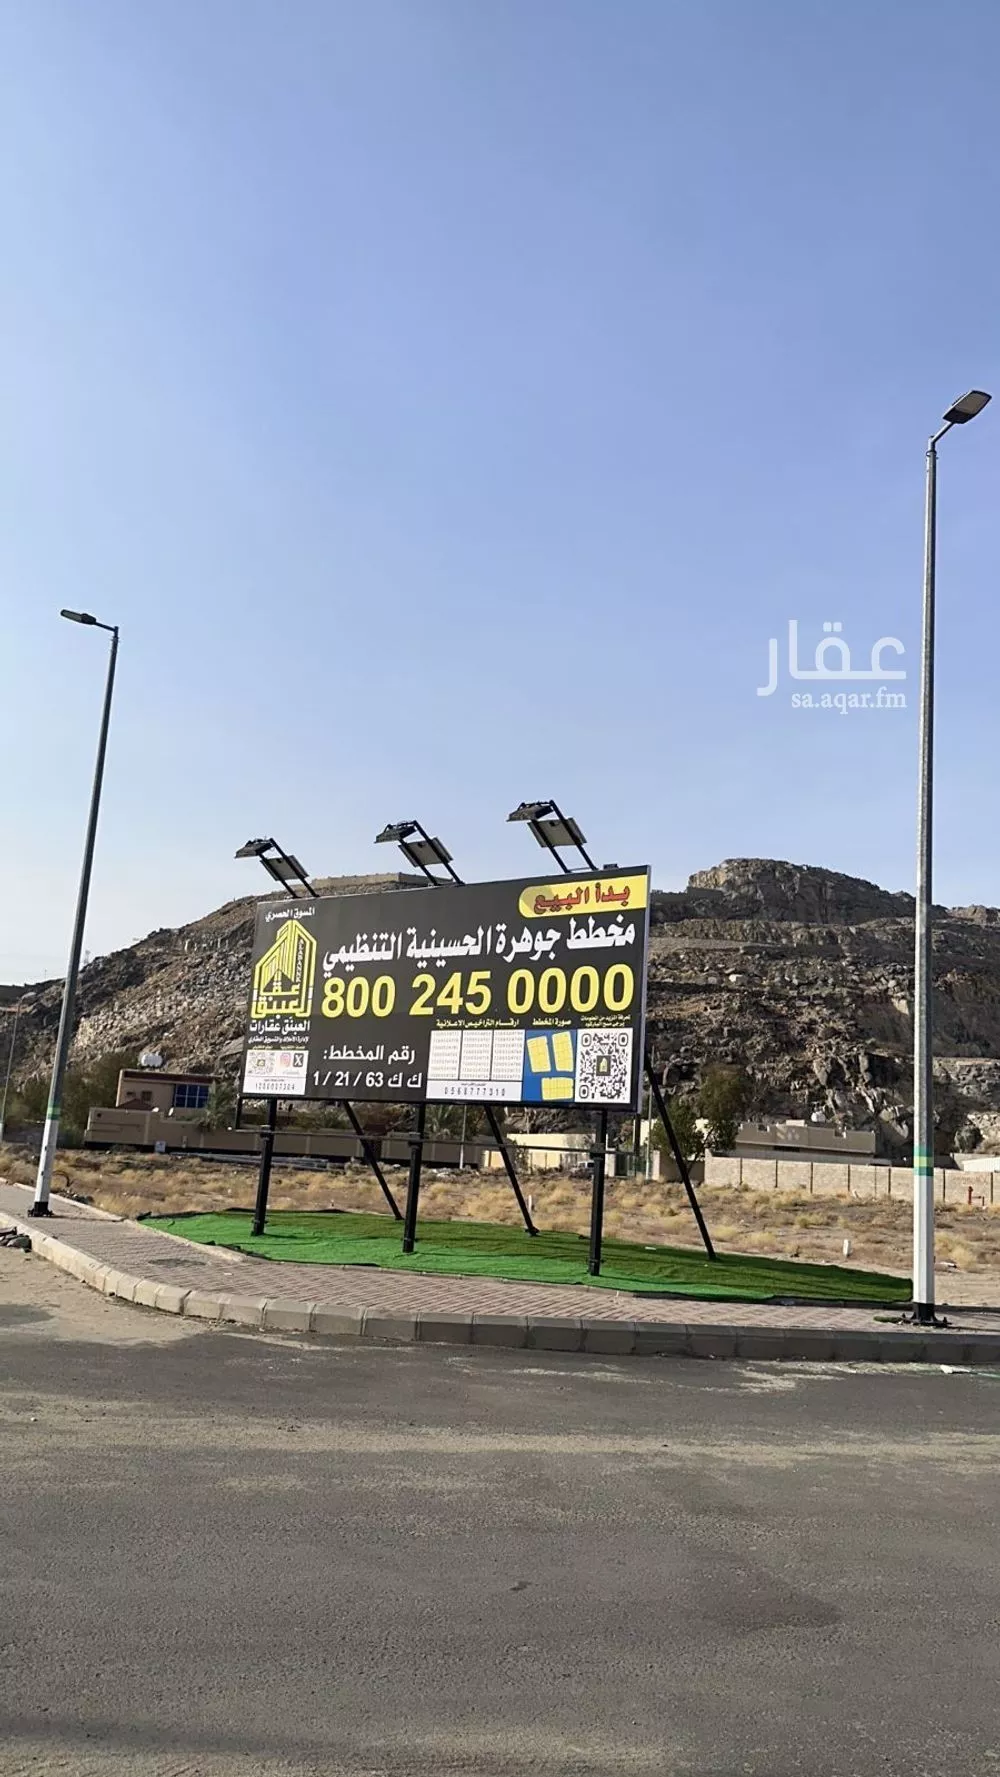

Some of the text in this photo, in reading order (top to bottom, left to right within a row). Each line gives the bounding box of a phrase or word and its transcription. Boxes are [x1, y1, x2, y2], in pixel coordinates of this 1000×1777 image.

[534, 882, 631, 915] بدأ البيع
[406, 924, 492, 968] الحسينية
[495, 923, 561, 963] جوهرة
[566, 914, 635, 949] مخطط
[322, 932, 402, 979] التنظيمي
[321, 964, 634, 1018] 800 245 0000
[249, 1019, 281, 1035] عقارات
[323, 1045, 415, 1065] رقم المخطط:
[313, 1070, 319, 1086] 1
[334, 1071, 350, 1086] 21
[365, 1071, 384, 1087] 63
